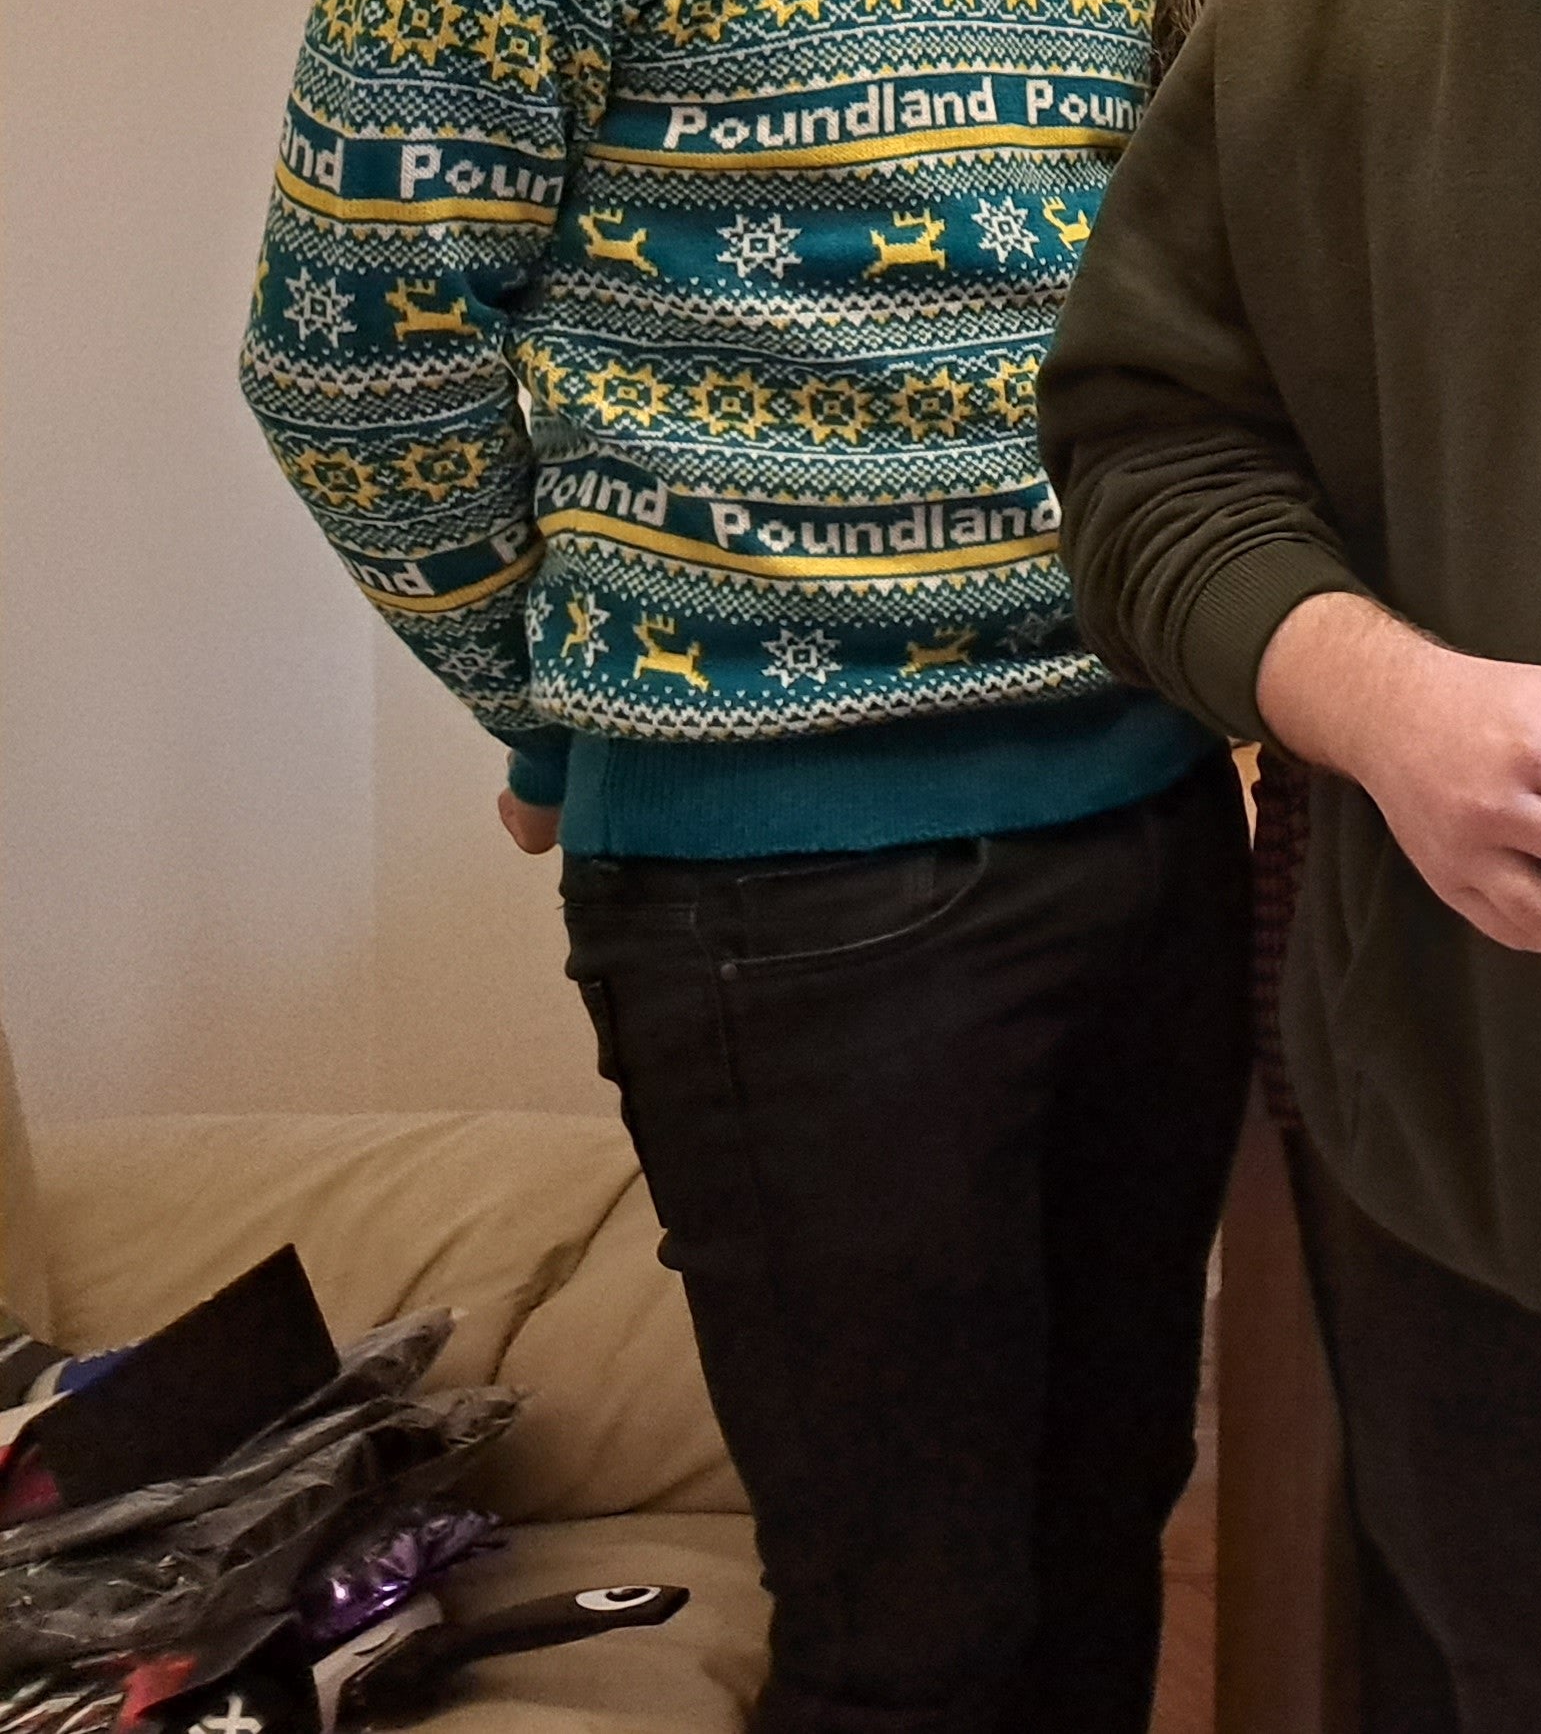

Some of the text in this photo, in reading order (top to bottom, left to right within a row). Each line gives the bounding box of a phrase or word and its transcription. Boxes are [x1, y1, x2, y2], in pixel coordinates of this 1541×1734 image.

[663, 75, 998, 150] Poundland
[709, 481, 1063, 556] Poundland
[350, 560, 435, 597] nd
